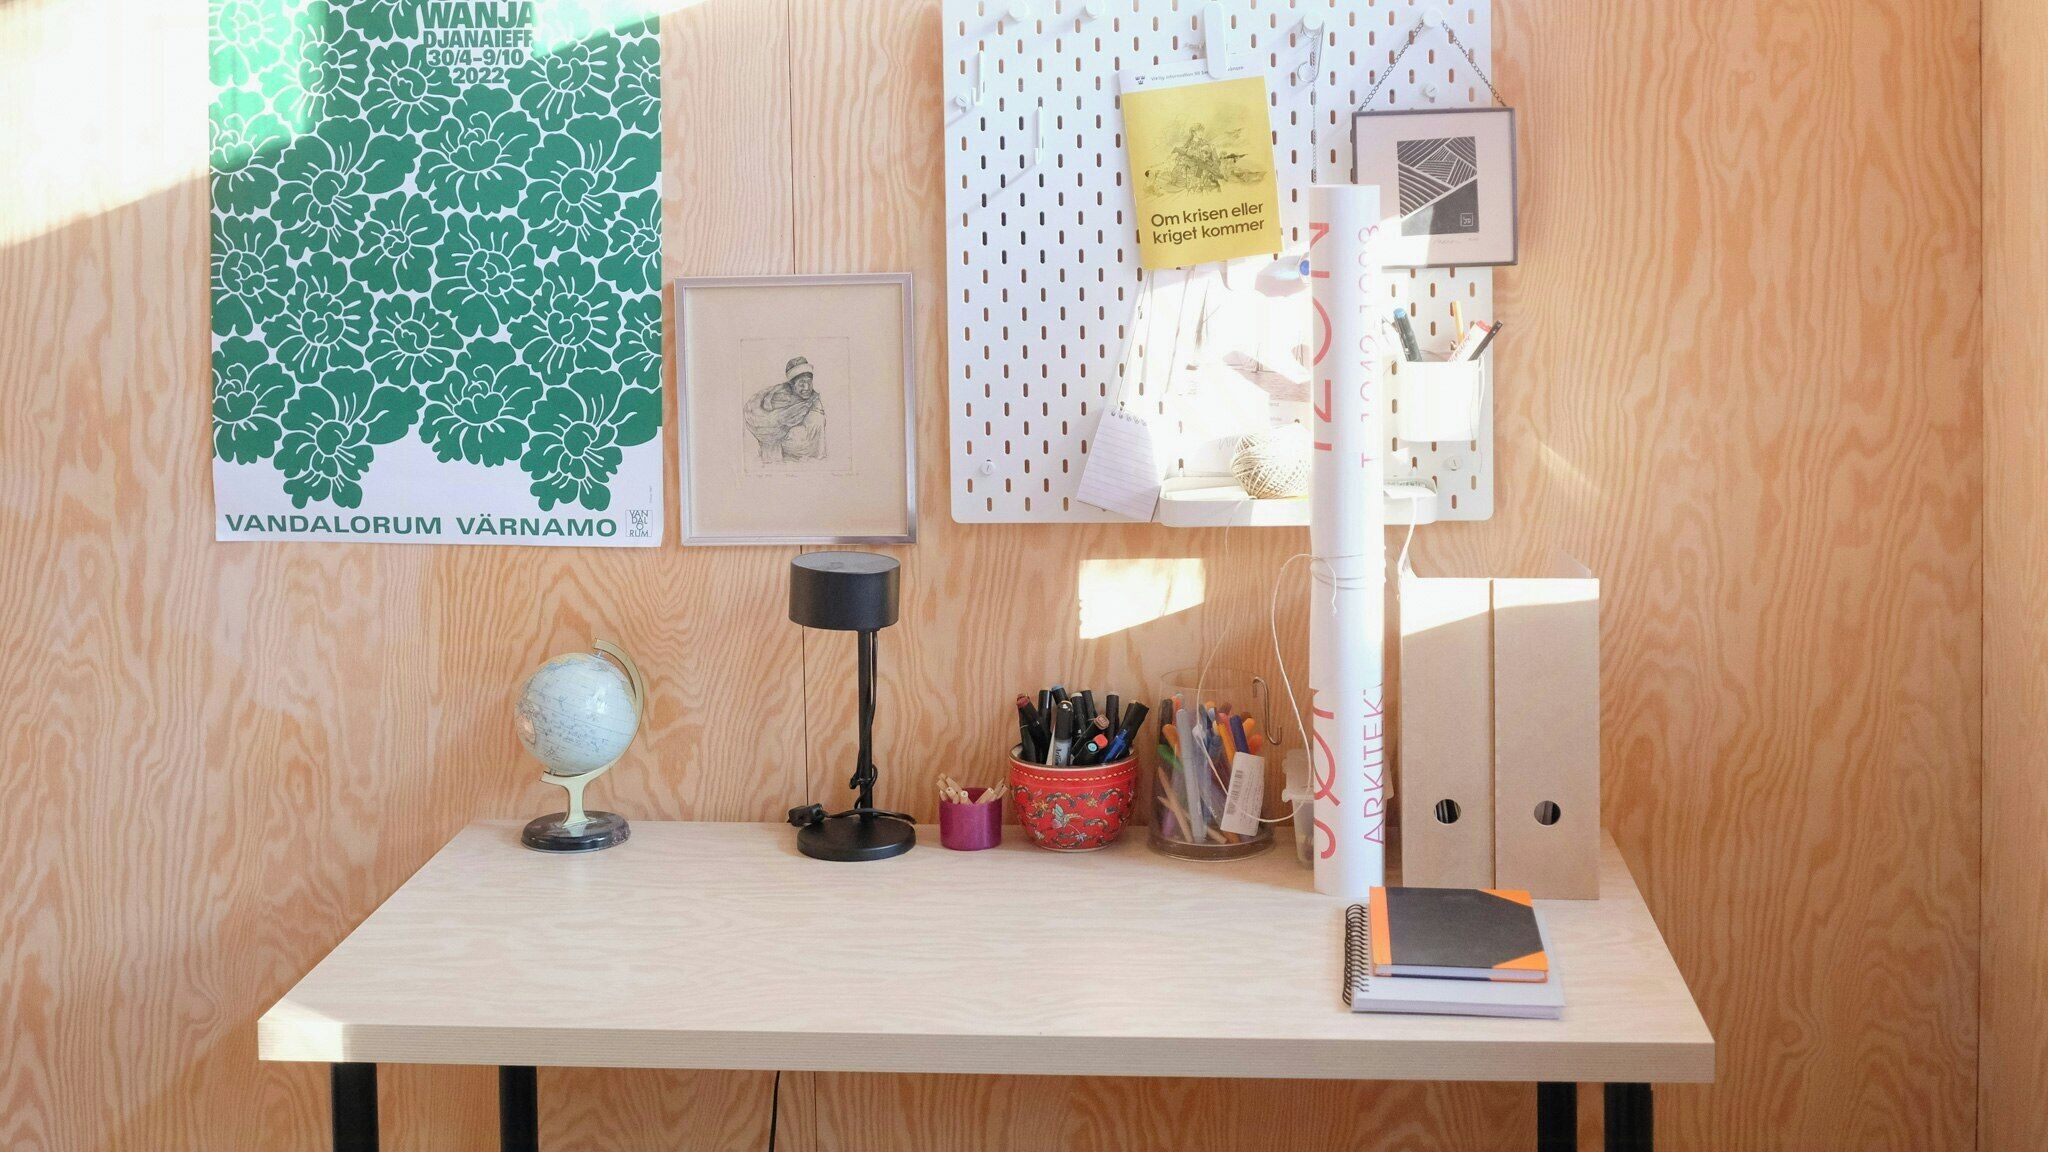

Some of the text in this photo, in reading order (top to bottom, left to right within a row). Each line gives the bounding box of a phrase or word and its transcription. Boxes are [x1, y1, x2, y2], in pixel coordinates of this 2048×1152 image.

[420, 1, 533, 28] WANJA
[423, 29, 533, 48] DJANAIEFF
[453, 67, 505, 84] 2022
[1151, 202, 1263, 227] Om krisen eller
[1153, 219, 1265, 245] kriget kommer
[225, 513, 617, 537] VANDALORUM VÄRNAMO
